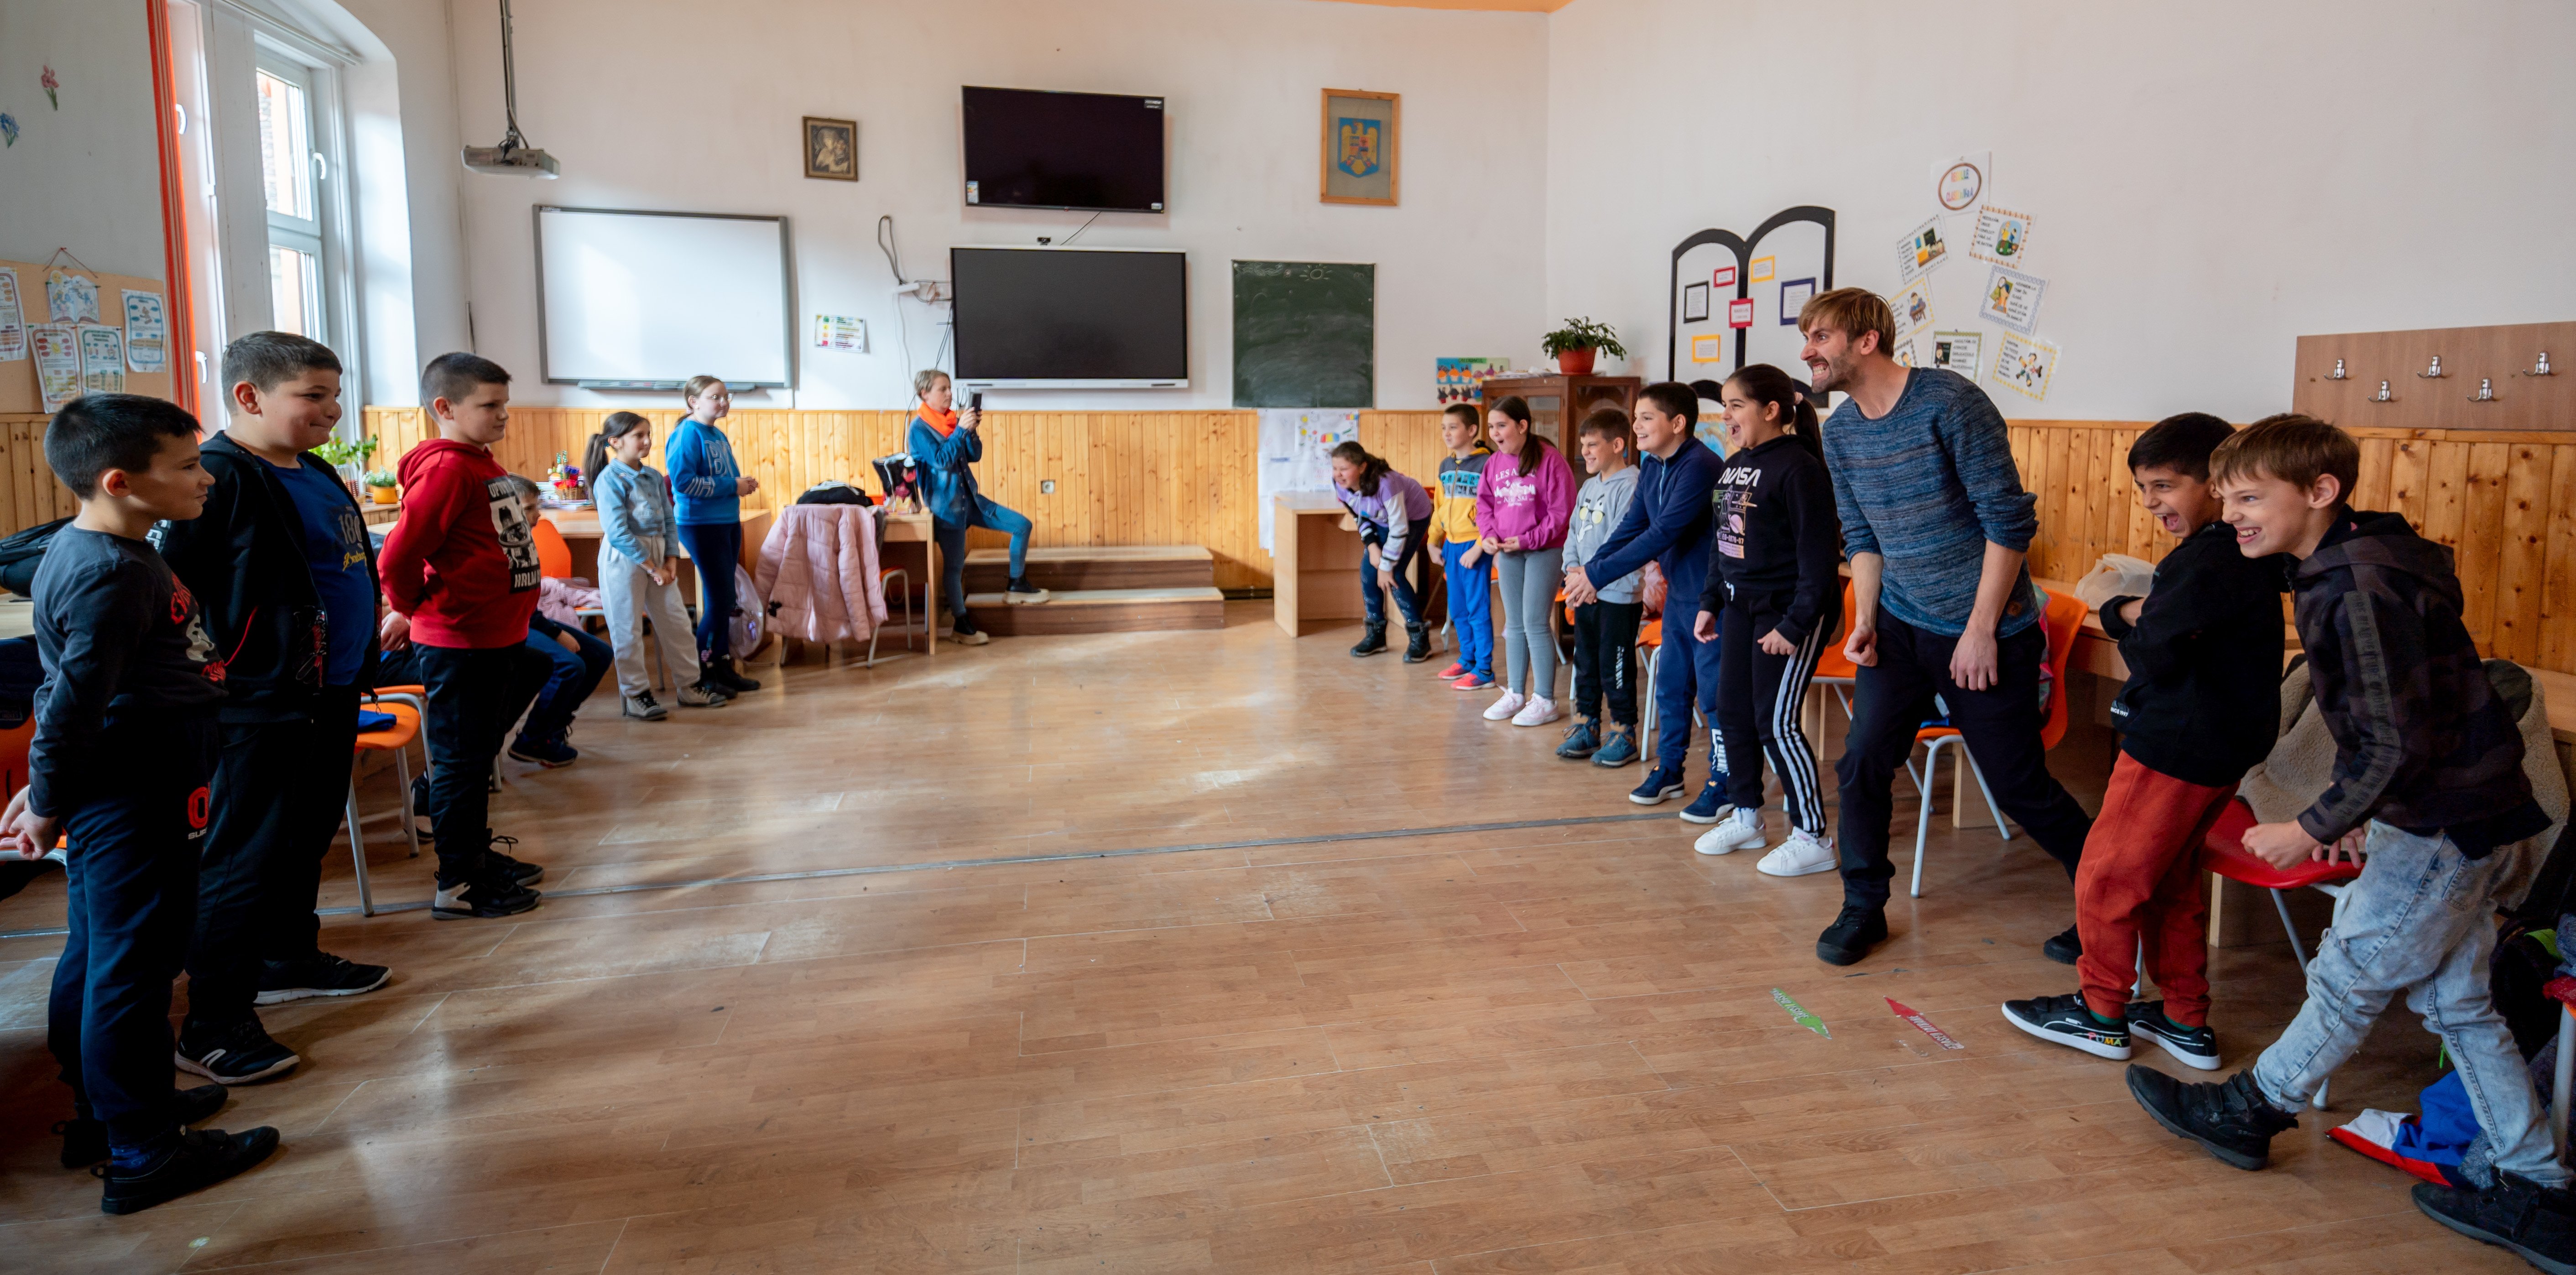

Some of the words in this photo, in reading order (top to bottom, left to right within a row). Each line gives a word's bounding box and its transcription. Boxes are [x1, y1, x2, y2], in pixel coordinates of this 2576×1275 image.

[1496, 468, 1509, 481] LES
[1718, 466, 1761, 487] NASA
[2088, 1031, 2122, 1047] PUMA
